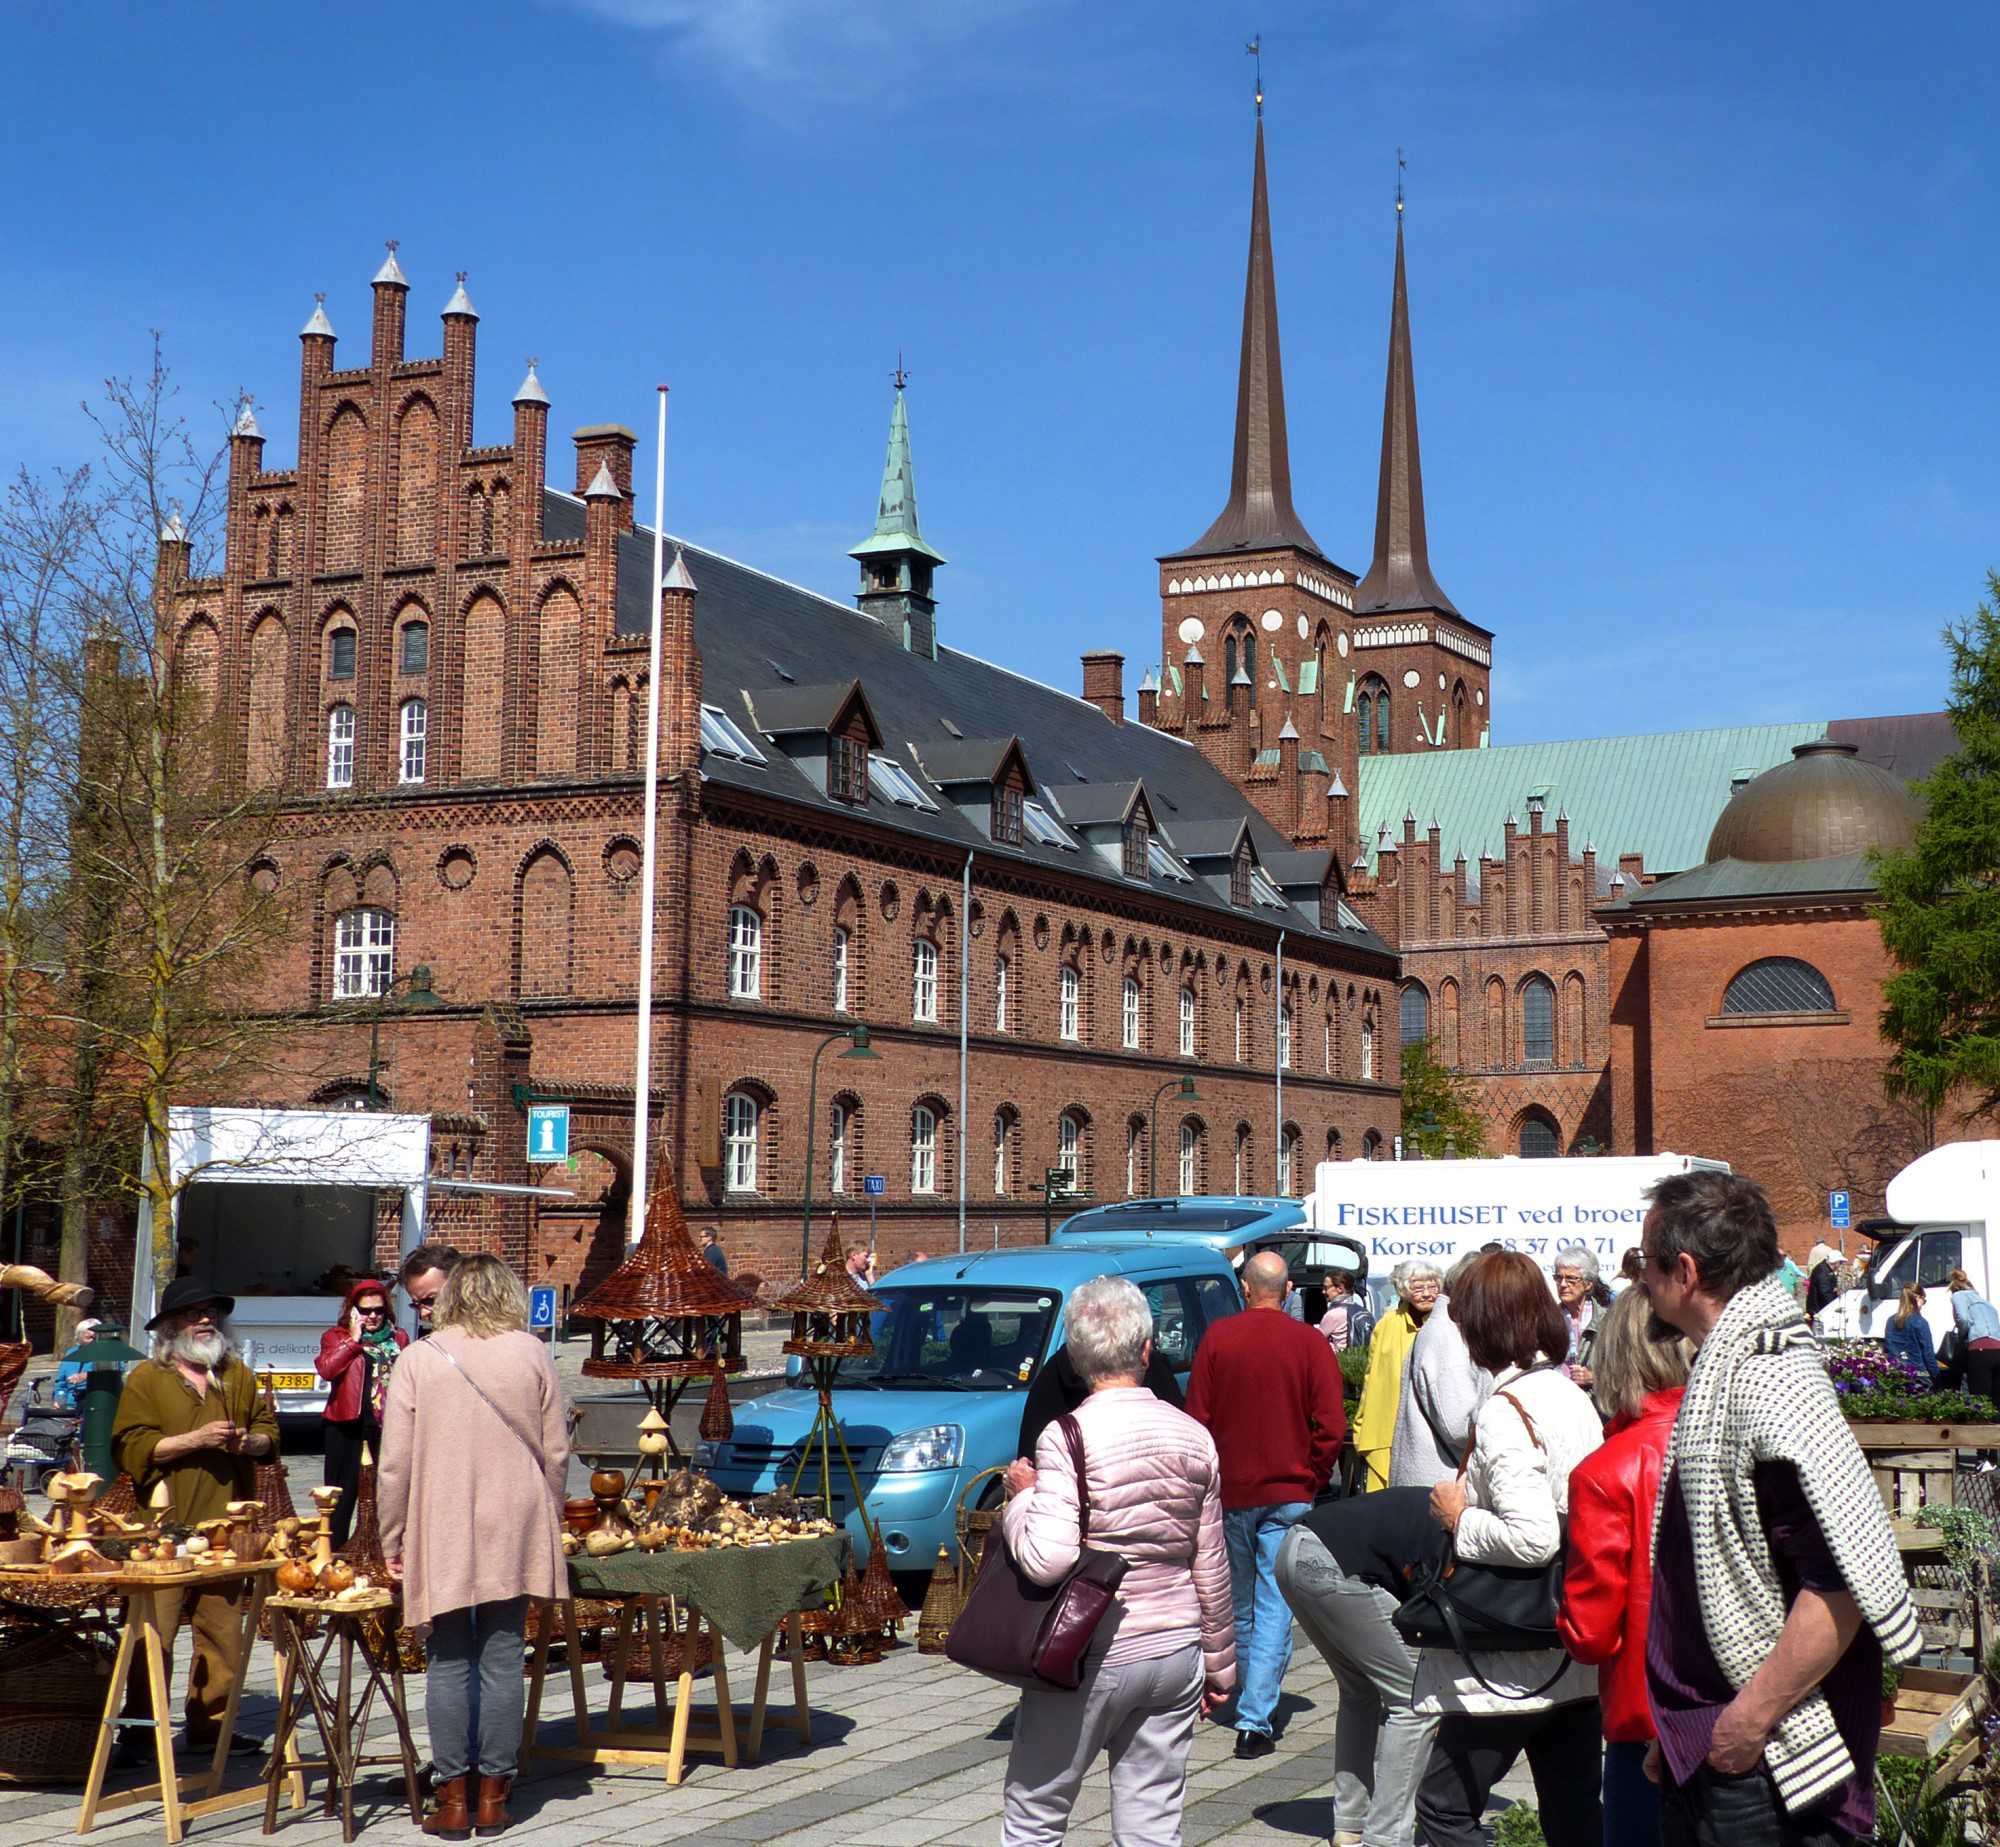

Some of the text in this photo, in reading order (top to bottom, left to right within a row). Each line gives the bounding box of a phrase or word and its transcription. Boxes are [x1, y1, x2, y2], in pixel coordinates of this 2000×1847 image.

[532, 1110, 566, 1119] TOURIST
[867, 1179, 882, 1192] TAXI
[1834, 1194, 1845, 1208] P
[1337, 1203, 1507, 1226] FISKEHUSET
[1518, 1205, 1562, 1224] ved
[1371, 1237, 1456, 1256] Korsør
[1524, 1237, 1549, 1254] 37
[1594, 1237, 1614, 1253] 71
[269, 1343, 320, 1354] delikate
